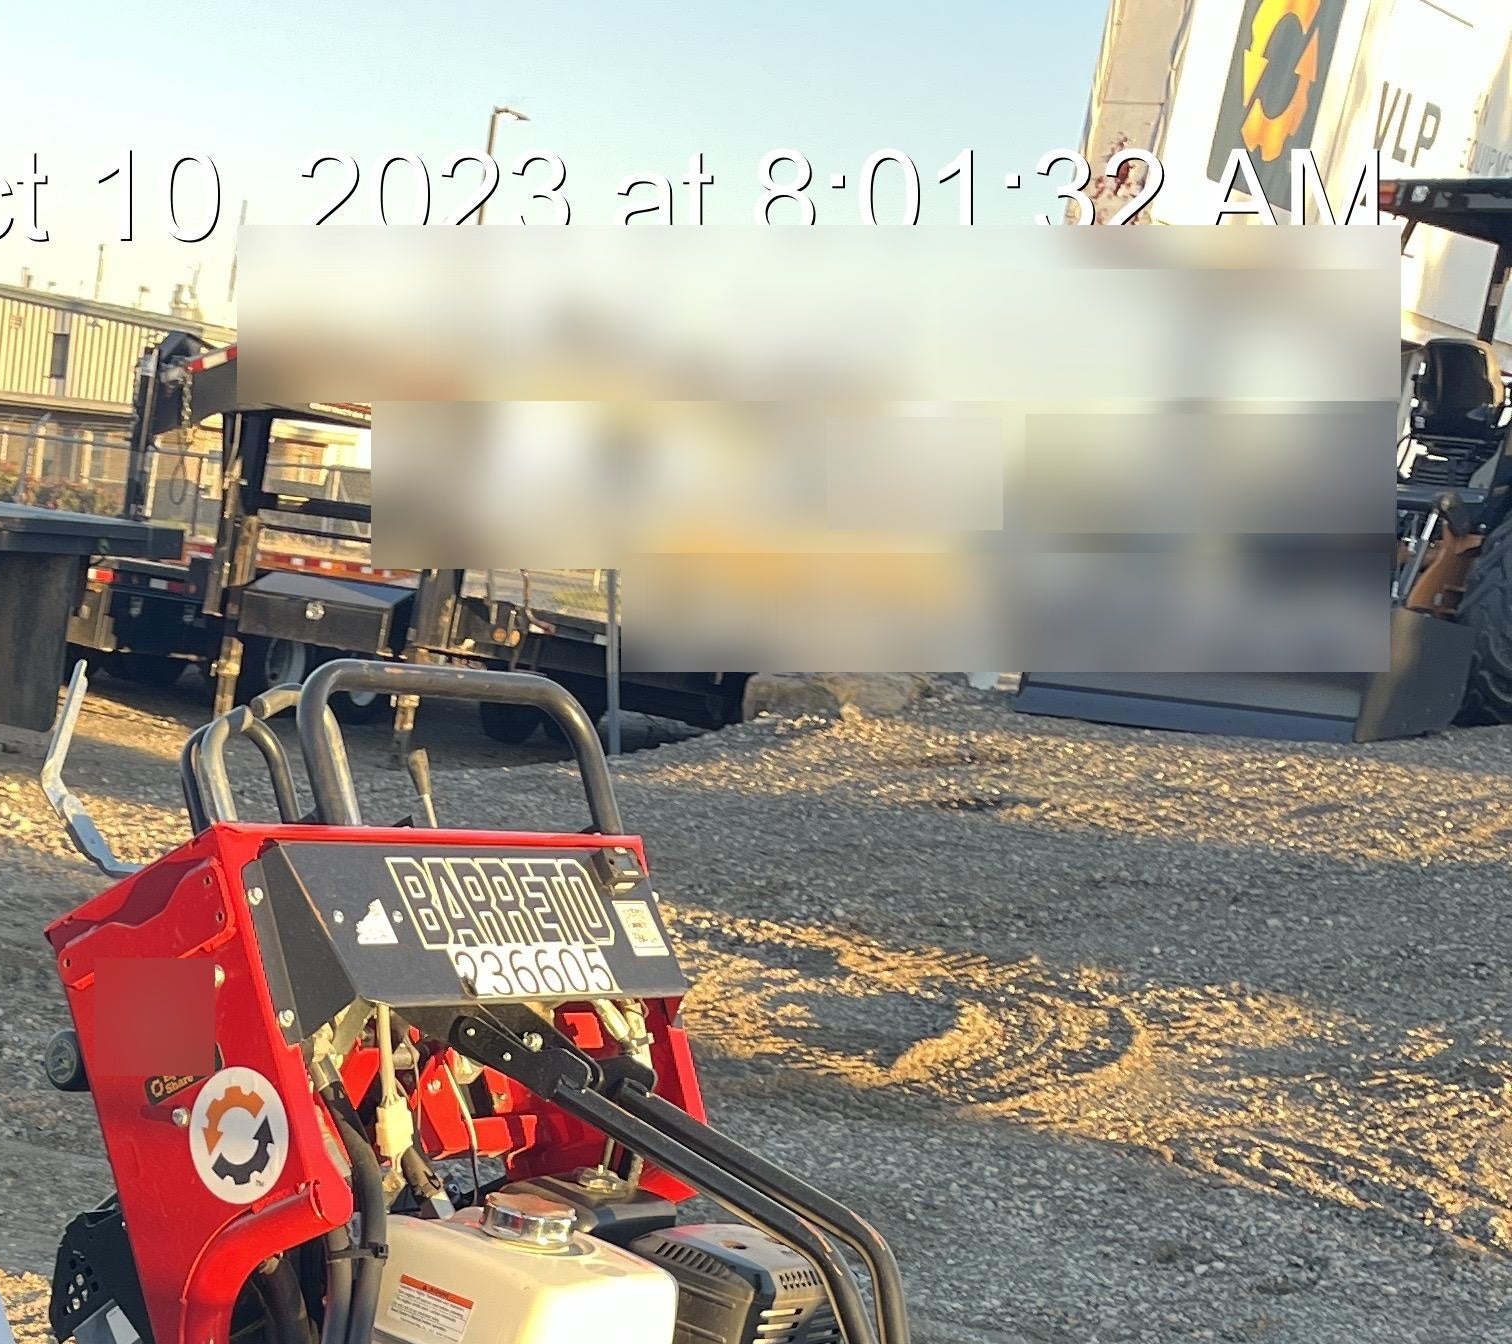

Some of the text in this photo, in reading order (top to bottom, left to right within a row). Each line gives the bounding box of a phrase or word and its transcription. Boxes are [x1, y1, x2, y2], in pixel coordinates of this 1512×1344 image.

[1373, 80, 1442, 168] VLP
[384, 857, 616, 950] BARRETO
[454, 948, 614, 997] 236605
[165, 1075, 194, 1094] Share
